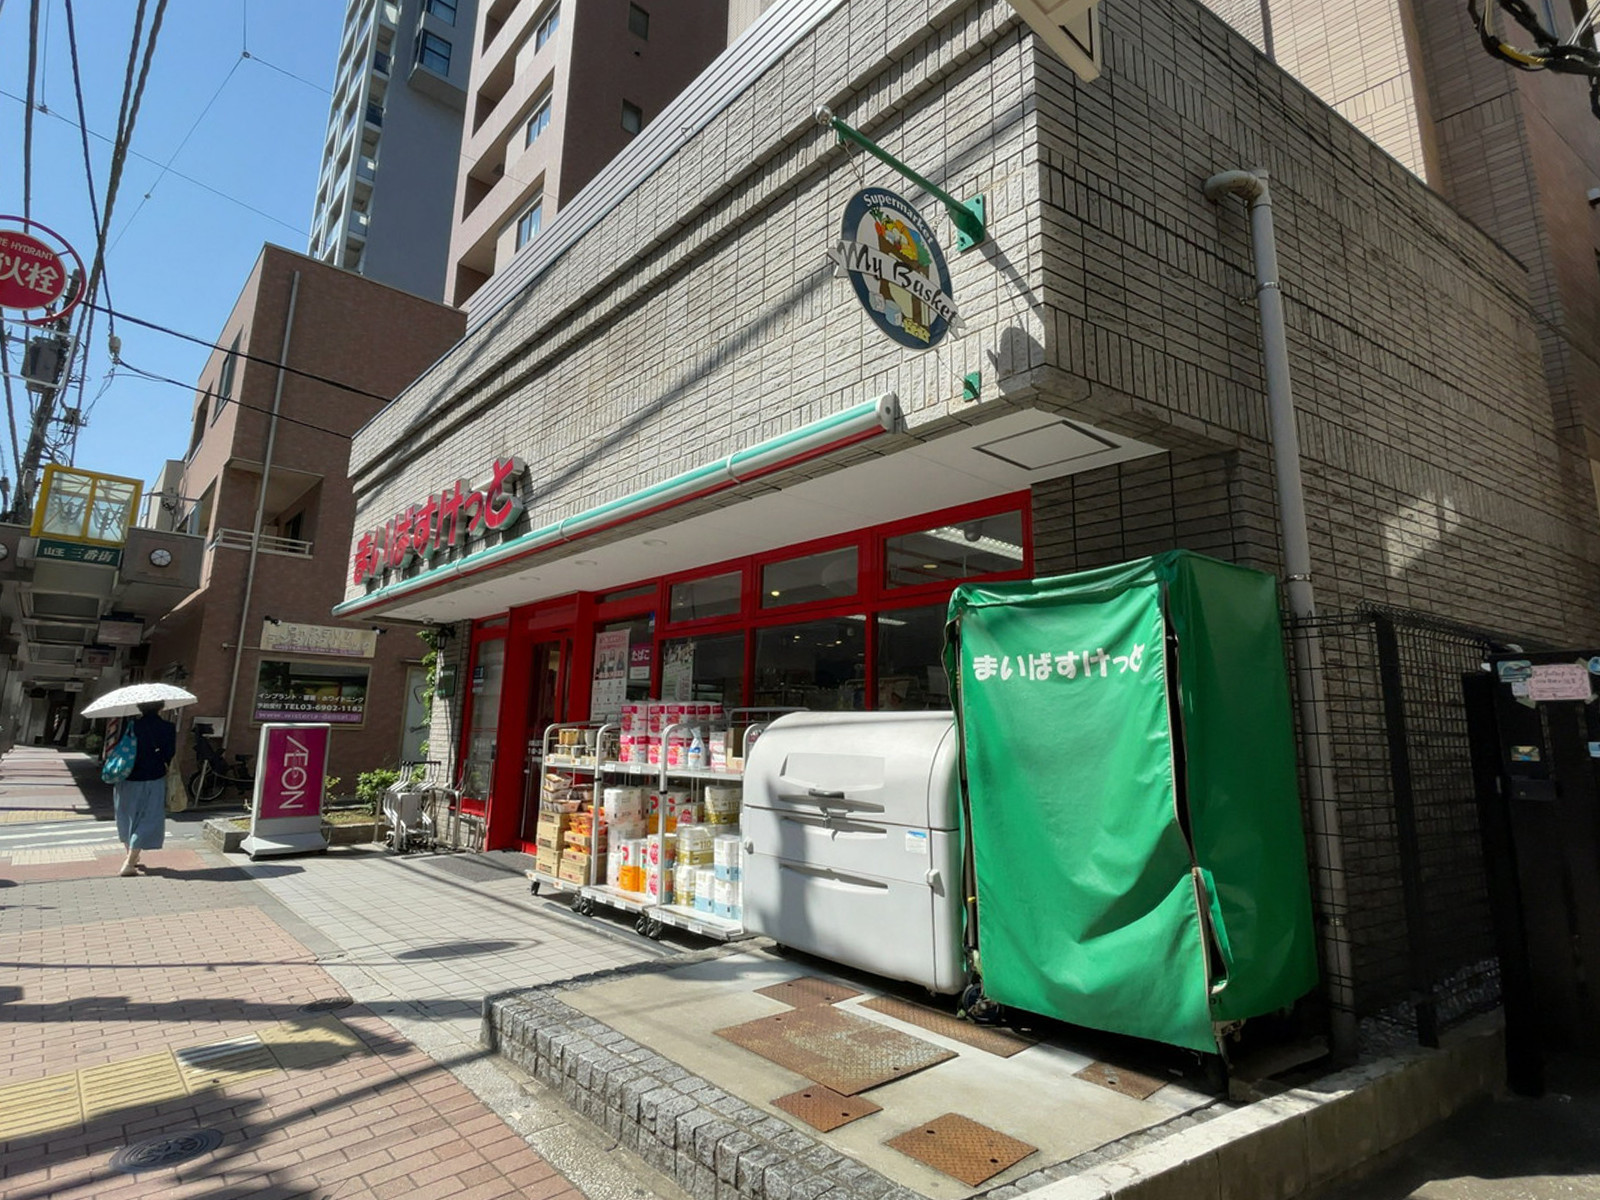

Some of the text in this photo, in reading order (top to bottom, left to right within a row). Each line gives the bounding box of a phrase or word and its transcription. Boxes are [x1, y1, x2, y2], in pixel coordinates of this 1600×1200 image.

[863, 193, 934, 245] Supermarket
[0, 252, 59, 295] 火栓
[11, 242, 54, 261] HYDRANT
[836, 241, 960, 325] My Basket
[353, 456, 516, 585] まいばすけっと
[631, 648, 651, 662] たばこ
[972, 643, 1145, 681] まいばすけっと
[279, 735, 310, 809] AEON
